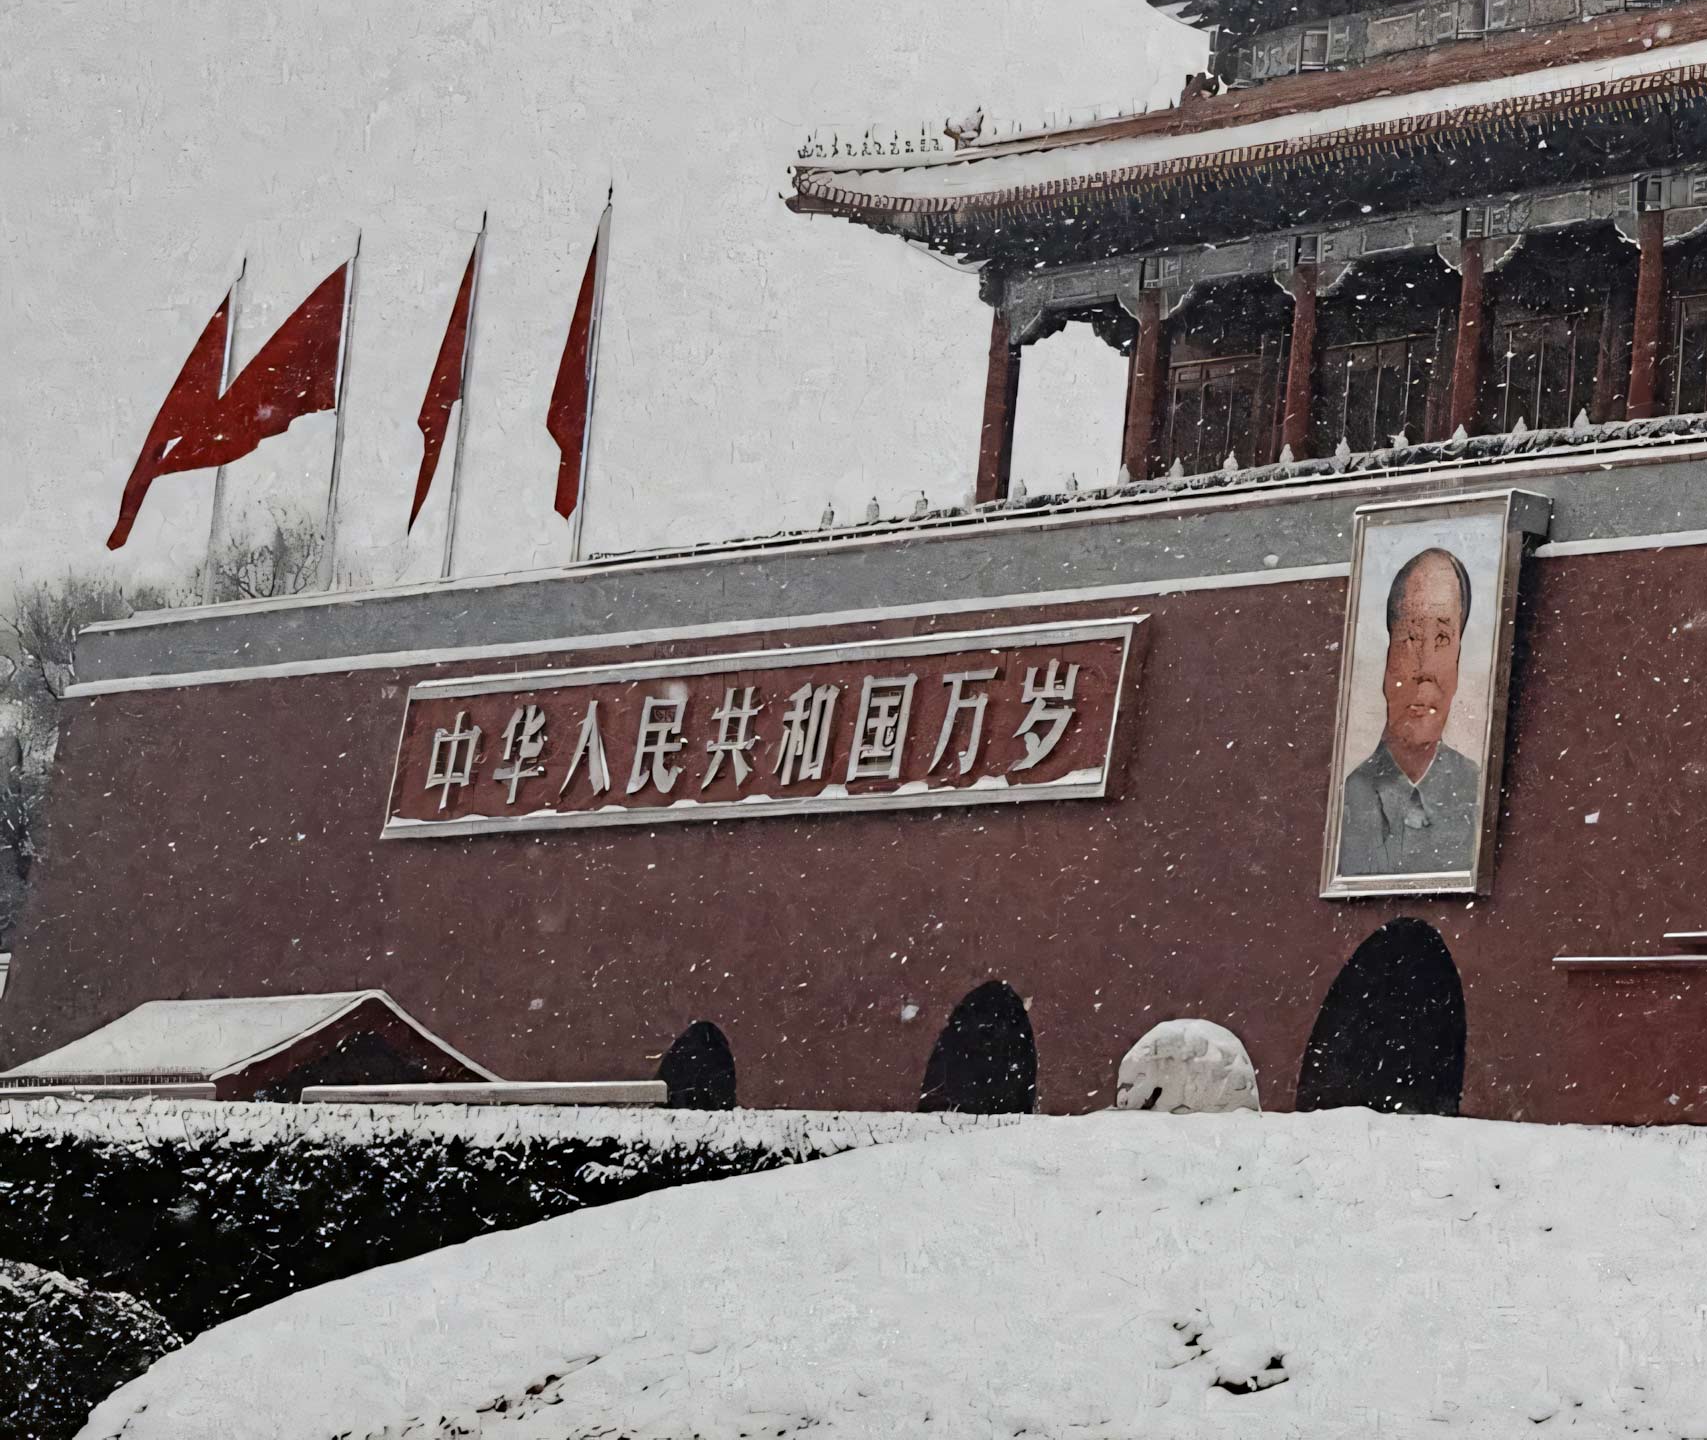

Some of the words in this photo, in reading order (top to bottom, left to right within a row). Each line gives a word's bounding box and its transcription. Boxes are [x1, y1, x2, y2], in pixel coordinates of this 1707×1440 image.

[425, 659, 1078, 810] 中华人民共和国万岁
